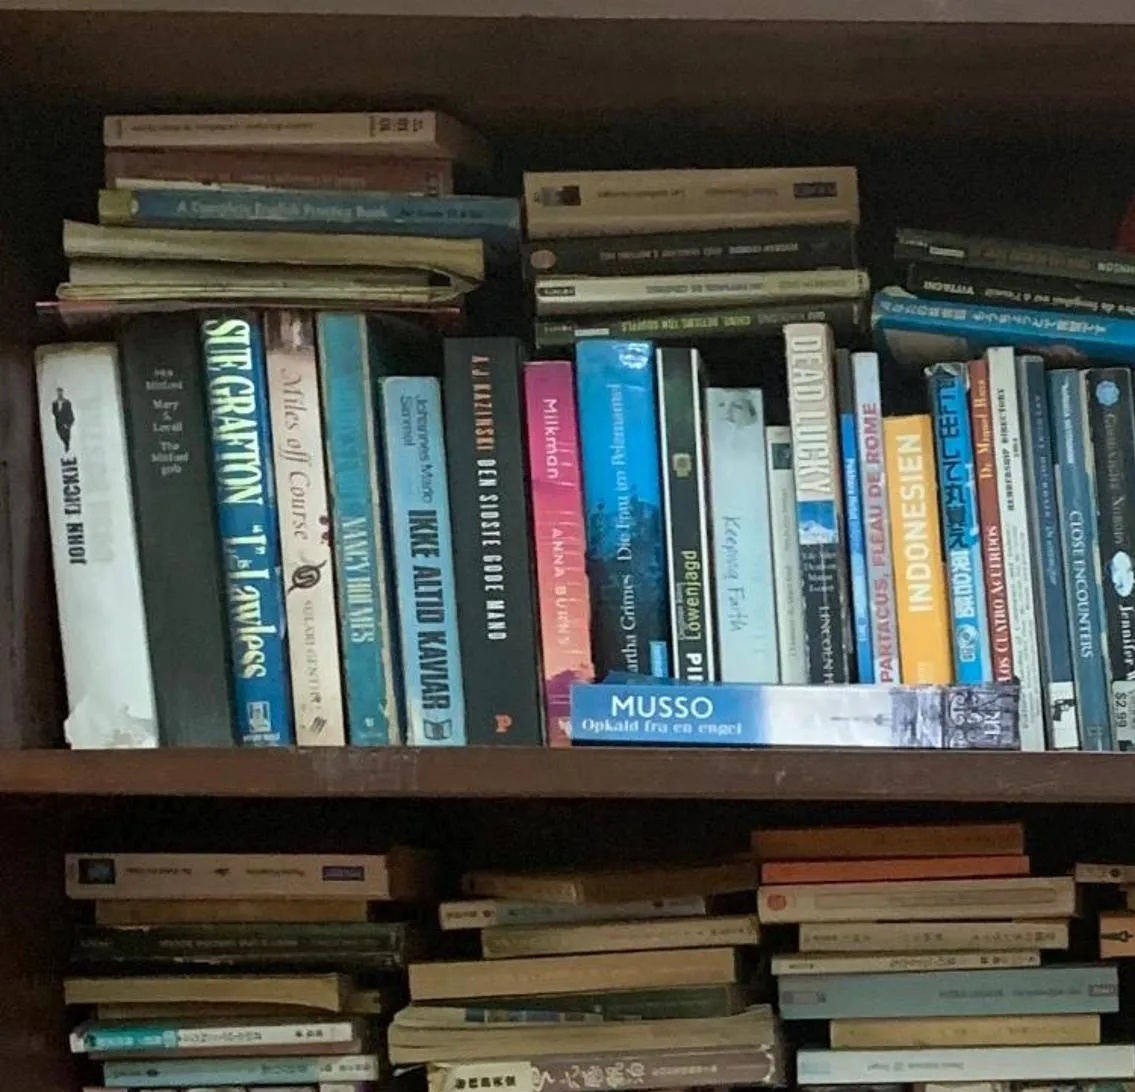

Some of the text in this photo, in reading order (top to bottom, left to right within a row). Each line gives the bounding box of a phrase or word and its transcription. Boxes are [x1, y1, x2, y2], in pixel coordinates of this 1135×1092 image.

[203, 318, 264, 505] SUE GRAFTON
[543, 398, 559, 480] Milkman
[790, 334, 833, 497] DEAD LUCKY
[280, 368, 311, 541] Miles off Course
[477, 458, 496, 488] DEN
[864, 402, 882, 503] DE ROME
[68, 519, 87, 564] JOHN
[479, 494, 500, 546] SIDSTE
[616, 533, 634, 561] Die
[896, 433, 934, 613] INDONESIEN
[483, 554, 504, 591] GODE
[550, 528, 565, 578] ANNA
[408, 509, 451, 710] IKKE ALTID KAVIAR
[620, 575, 638, 631] Grimes
[1068, 510, 1094, 659] CLOSE ENCOUNTERS
[486, 600, 507, 641] MAND
[1118, 604, 1135, 666] Jennifer
[611, 696, 714, 720] MUSSO
[644, 720, 669, 734] fra
[673, 721, 694, 734] en
